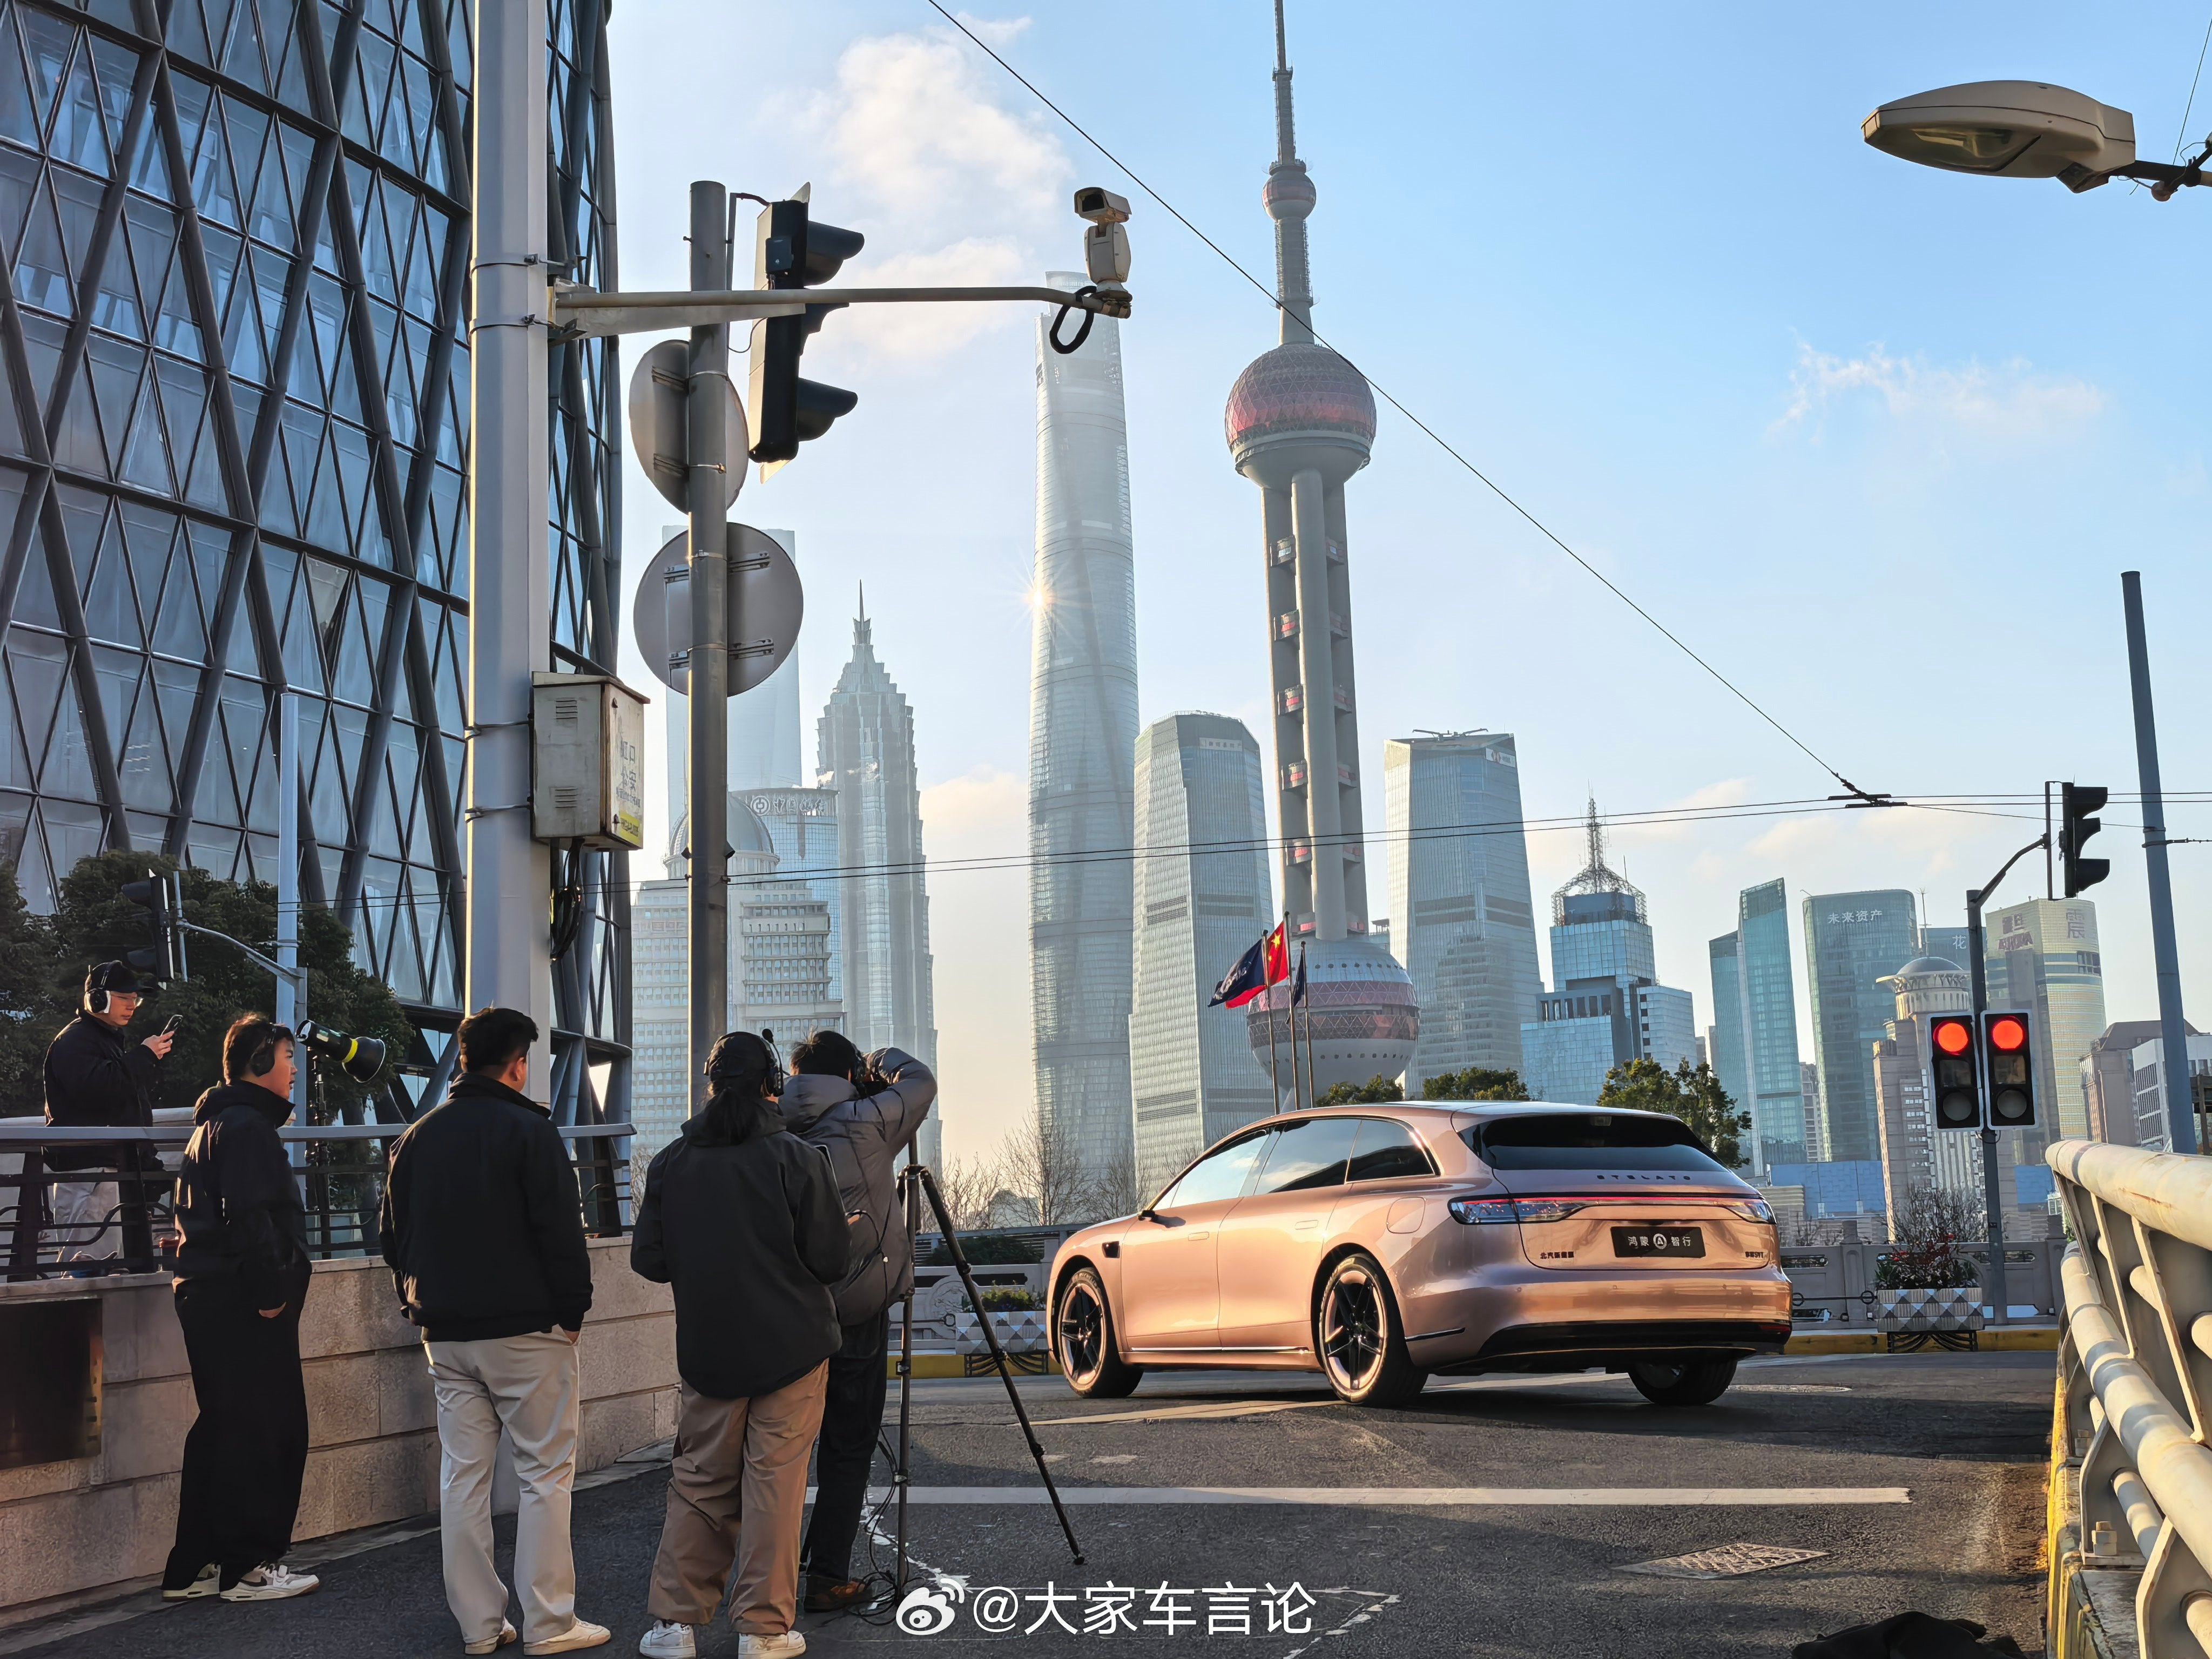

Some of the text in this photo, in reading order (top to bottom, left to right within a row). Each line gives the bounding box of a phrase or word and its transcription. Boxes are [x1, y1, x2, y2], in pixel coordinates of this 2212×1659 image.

[621, 765, 636, 792] 公安
[1827, 909, 1883, 924] 未来资产
[2065, 908, 2085, 939] 震
[1952, 935, 1966, 949] 花
